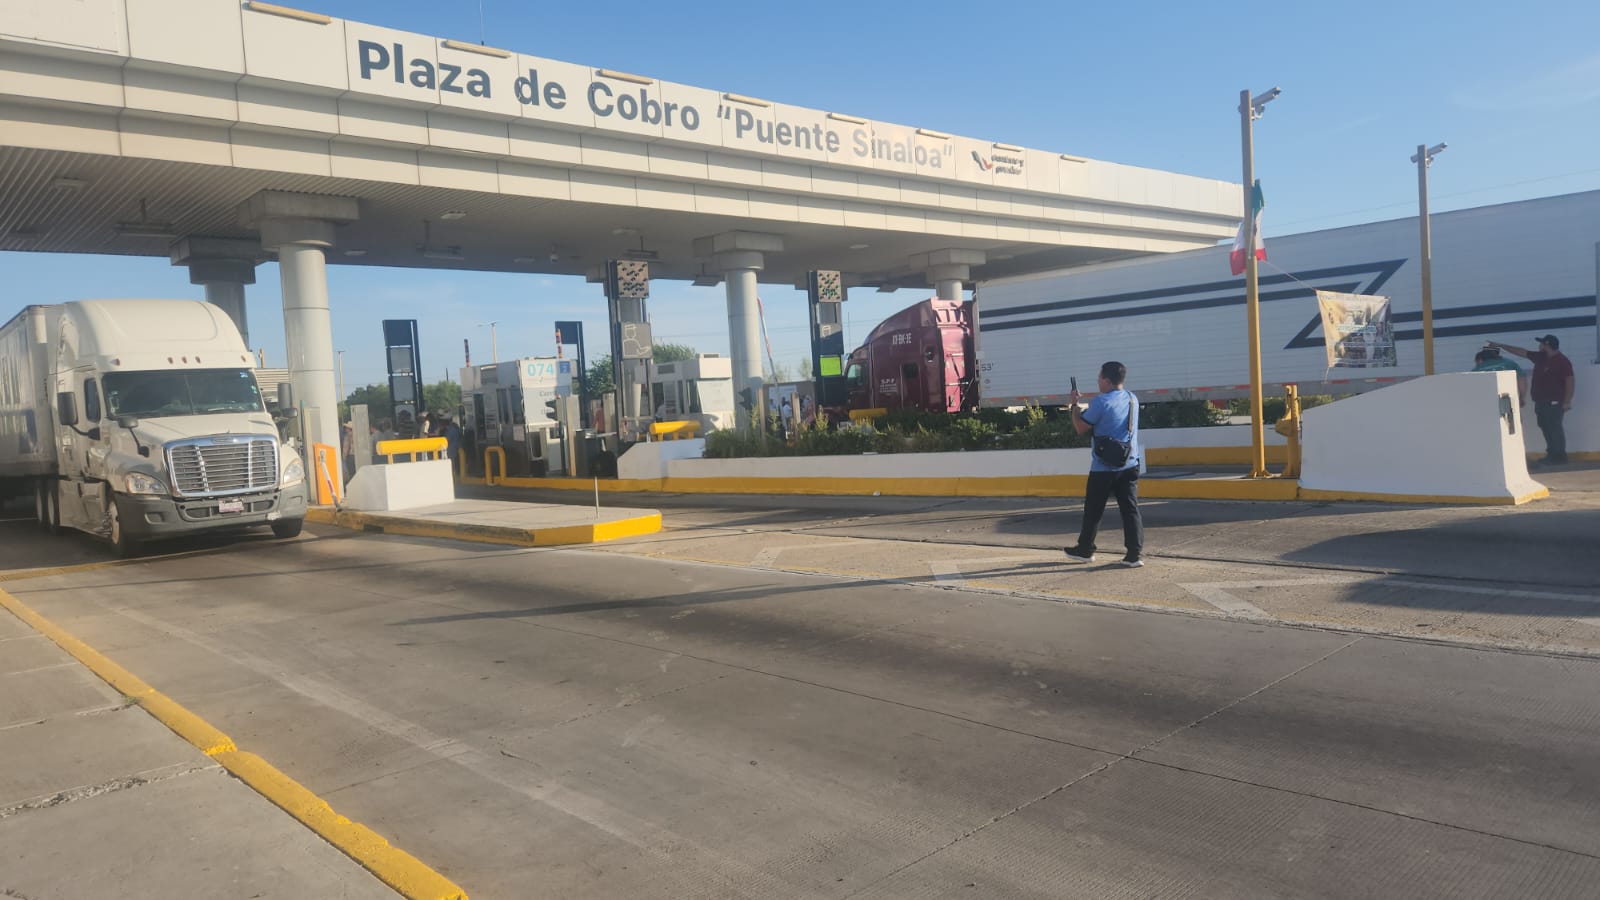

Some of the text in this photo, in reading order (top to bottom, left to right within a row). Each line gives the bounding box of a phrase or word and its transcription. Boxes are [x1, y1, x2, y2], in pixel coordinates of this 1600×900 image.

[358, 39, 952, 169] Plaza de Cobro "Puente Sinaloa"
[527, 363, 554, 377] 074
